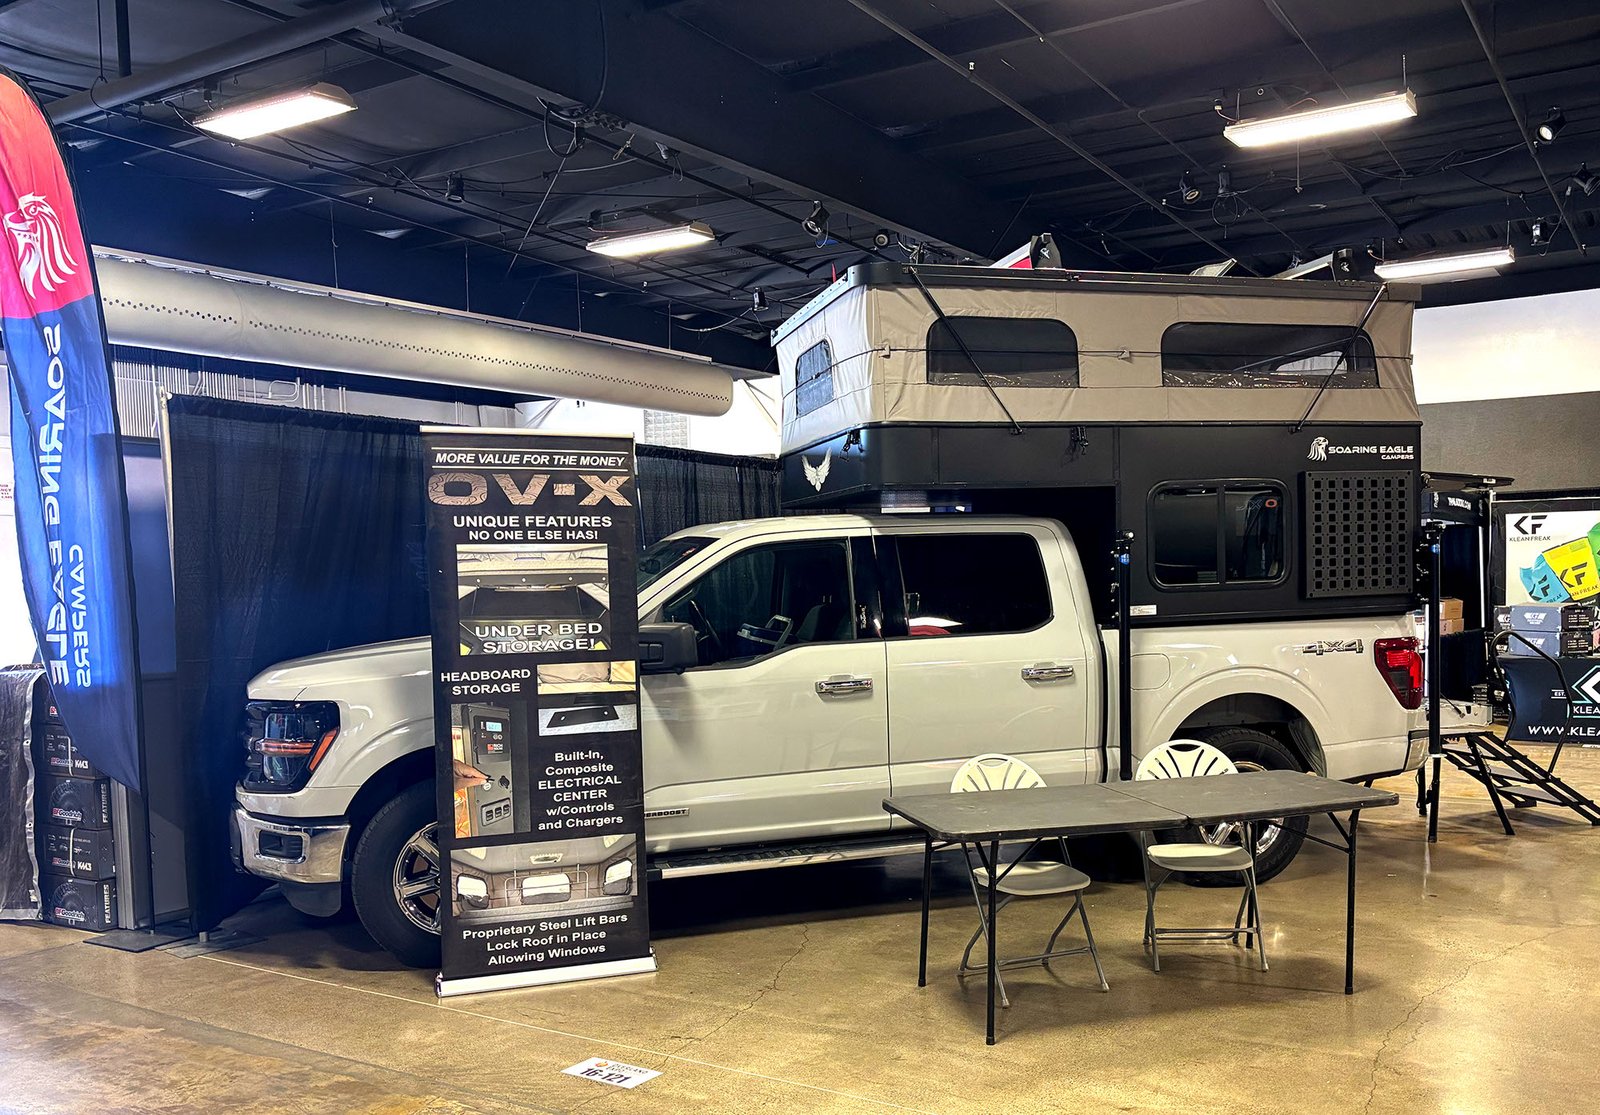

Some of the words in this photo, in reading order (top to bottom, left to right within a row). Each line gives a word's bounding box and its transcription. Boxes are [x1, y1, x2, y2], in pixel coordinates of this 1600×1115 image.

[1328, 445, 1378, 454] SOARING
[1379, 445, 1414, 454] EAGLE
[435, 452, 475, 464] MORE
[478, 453, 521, 465] VALUE
[522, 454, 550, 465] FOR
[552, 455, 577, 466] THE
[579, 455, 625, 467] MONEY
[427, 472, 633, 507] OV-X
[453, 515, 520, 528] UNIQUE
[525, 515, 613, 528] FEATURES
[1513, 514, 1548, 535] KF
[468, 530, 490, 541] NO
[493, 530, 524, 541] ONE
[527, 530, 563, 540] ELSE
[566, 530, 598, 540] HAS!
[475, 623, 553, 638] UNDER
[559, 622, 603, 635] BED
[482, 638, 596, 654] STORAGE!
[440, 669, 531, 682] HEADBOARD
[452, 682, 521, 696] STORAGE
[554, 750, 604, 762] Built-In,
[545, 763, 614, 777] Composite
[538, 776, 622, 790] ELECTRICAL
[553, 789, 608, 802] CENTER
[546, 802, 615, 816] w/Controls
[644, 809, 687, 818] ERBOOST
[538, 820, 562, 831] and
[565, 815, 624, 830] Chargers
[103, 884, 111, 924] FEATURES
[462, 924, 536, 940] Proprietary
[539, 918, 572, 931] Steel
[575, 917, 596, 928] Lift
[599, 913, 628, 925] Bars
[487, 940, 519, 952] Lock
[522, 936, 554, 948] Roof
[556, 934, 568, 944] in
[572, 930, 607, 942] Place
[488, 951, 545, 966] Allowing
[548, 944, 606, 959] Windows
[580, 1067, 632, 1084] 16-121
